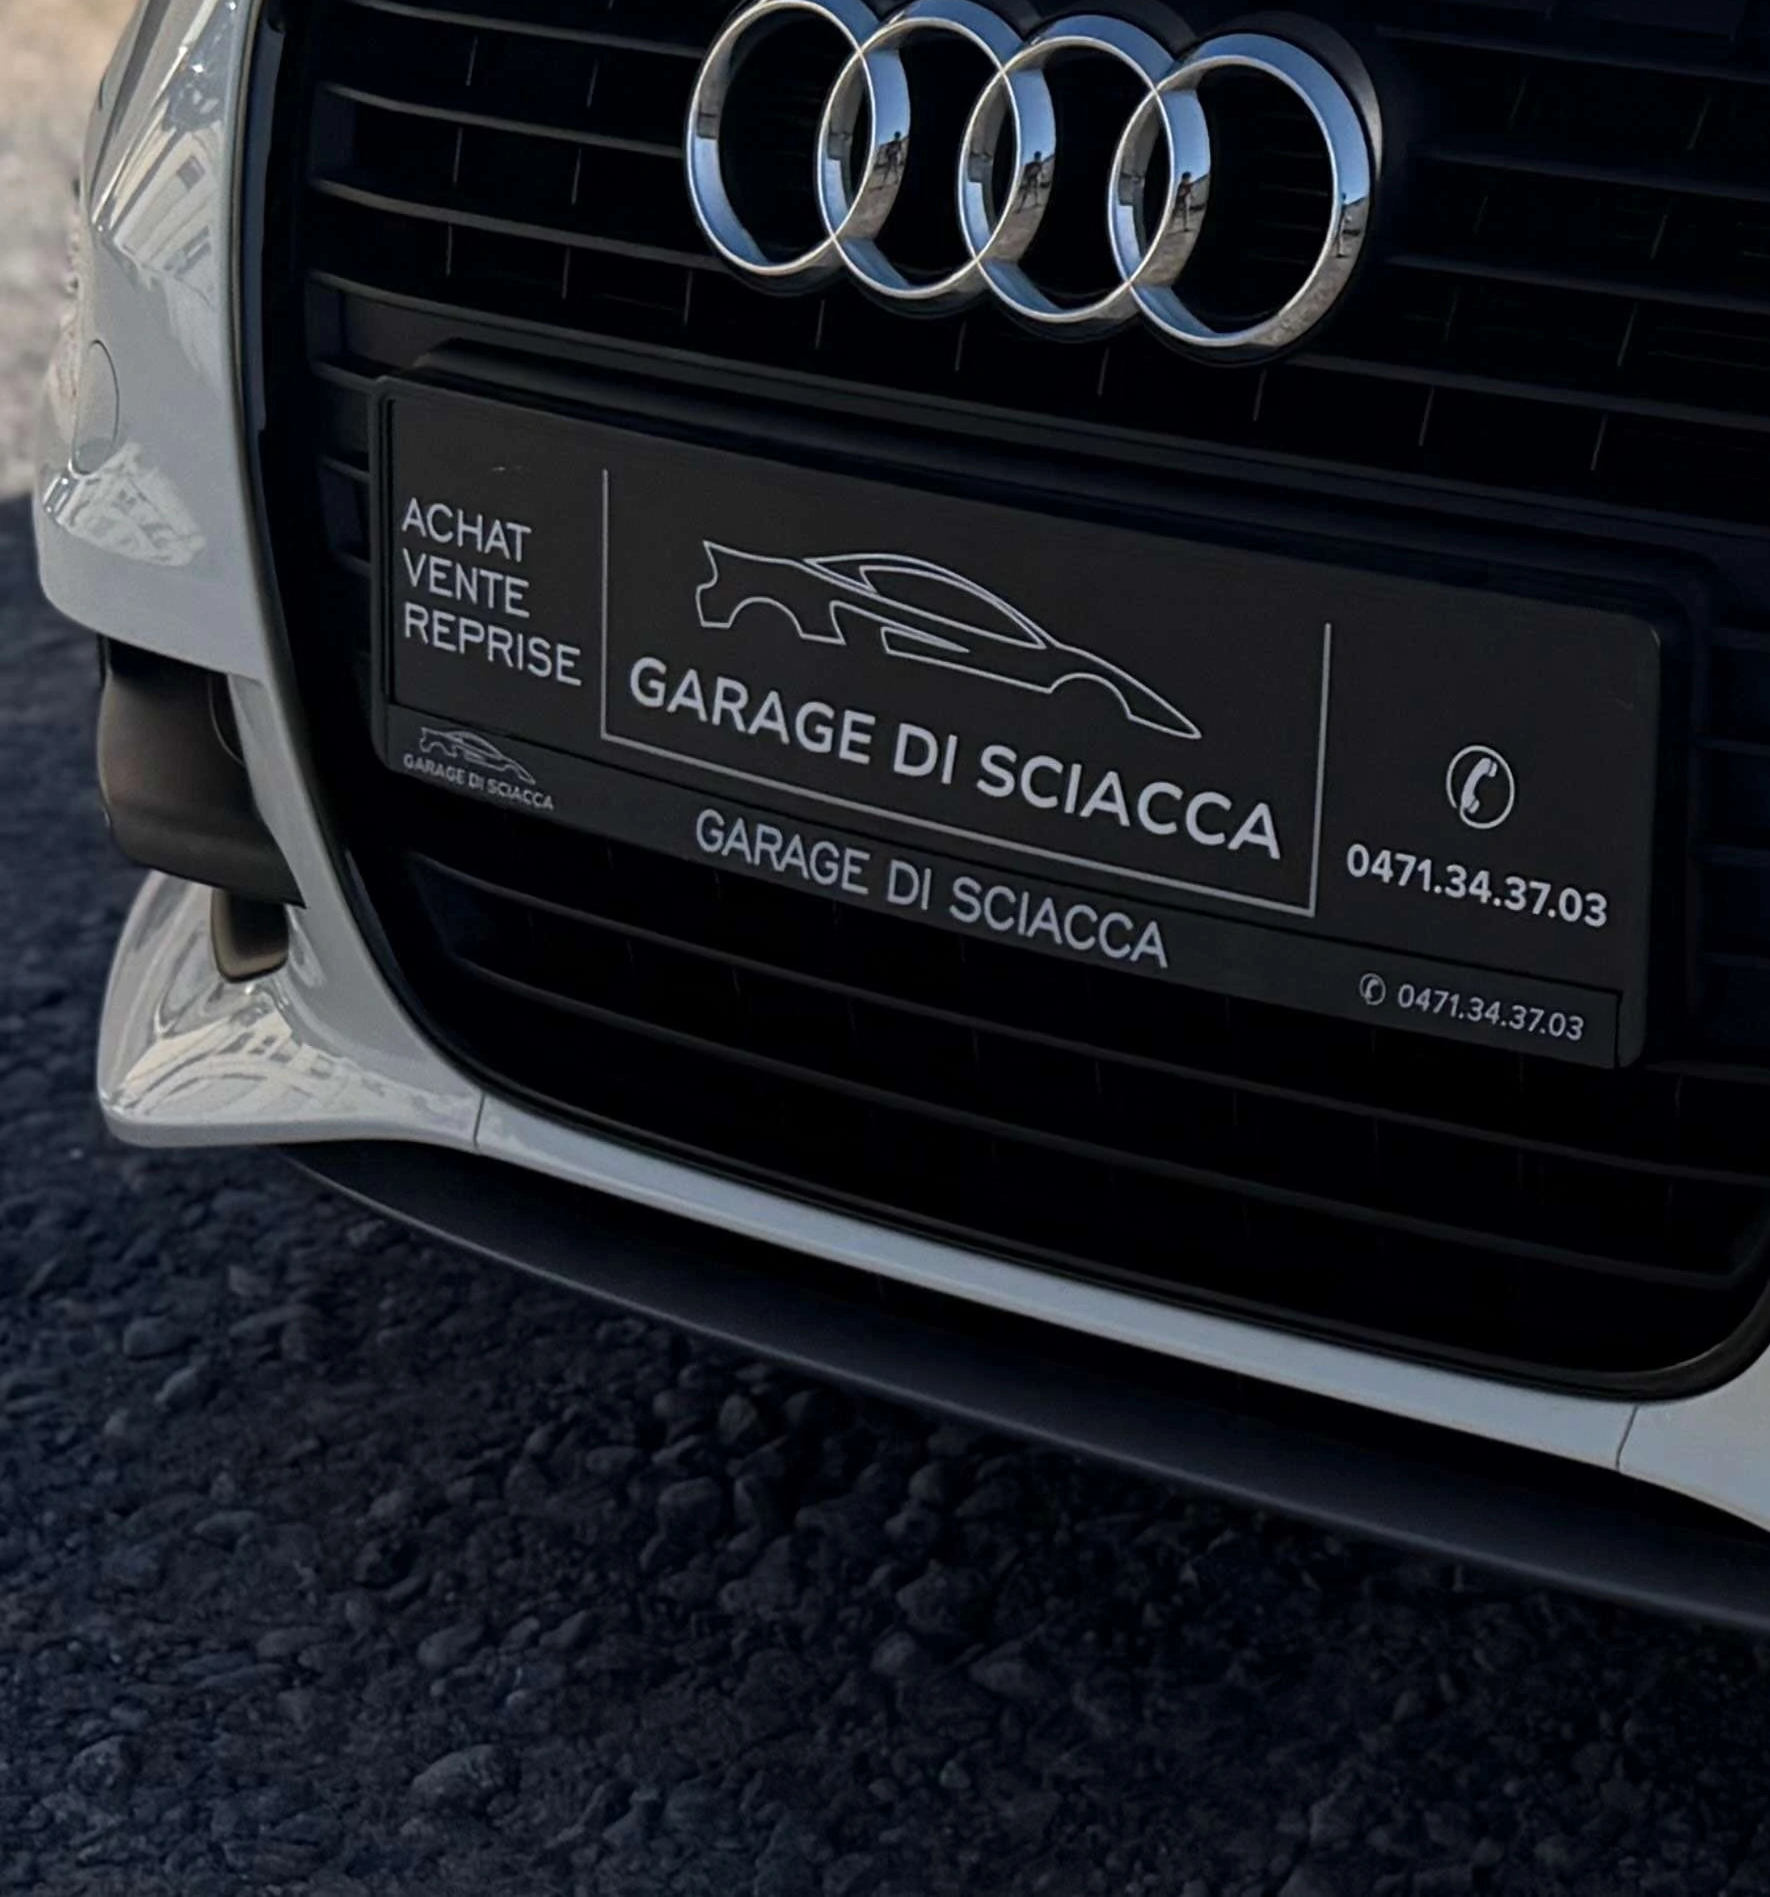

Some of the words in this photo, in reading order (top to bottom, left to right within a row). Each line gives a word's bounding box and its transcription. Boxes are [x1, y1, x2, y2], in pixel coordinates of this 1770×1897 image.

[402, 497, 532, 562] ACHAT
[403, 548, 530, 618] VENTE
[405, 601, 582, 686] REPRISE
[403, 753, 466, 785] GARAGE
[468, 772, 484, 791] DI
[487, 778, 555, 810] SCIACCA
[629, 657, 876, 764] GARAGE
[893, 722, 957, 784] DI
[975, 744, 1281, 860] SCIACCA
[695, 808, 870, 895] GARAGE
[887, 859, 932, 910] DI
[949, 876, 1168, 969] SCIACCA
[1346, 843, 1607, 927] 0471.34.37.03
[1397, 984, 1584, 1041] 0471.34.37.03
